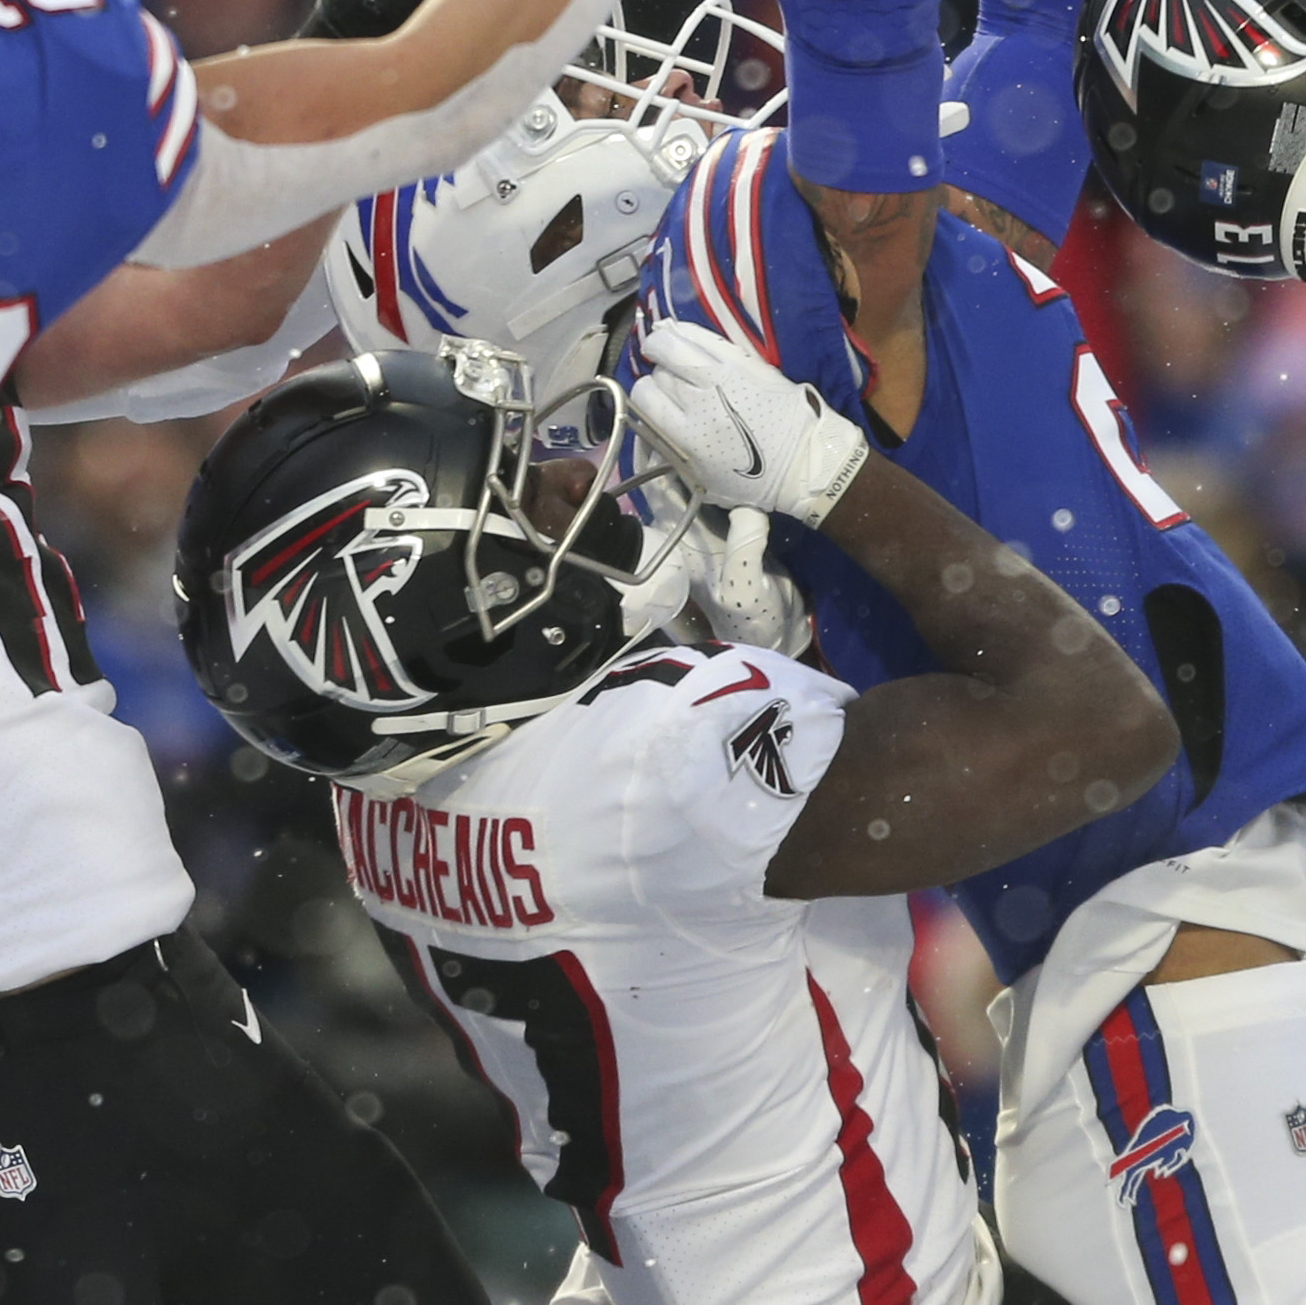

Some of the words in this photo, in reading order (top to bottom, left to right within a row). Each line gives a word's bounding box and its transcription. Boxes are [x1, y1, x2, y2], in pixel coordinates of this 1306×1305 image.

[1214, 220, 1275, 264] 13
[825, 448, 865, 501] NOTHING
[331, 781, 555, 928] ACCHEAUS
